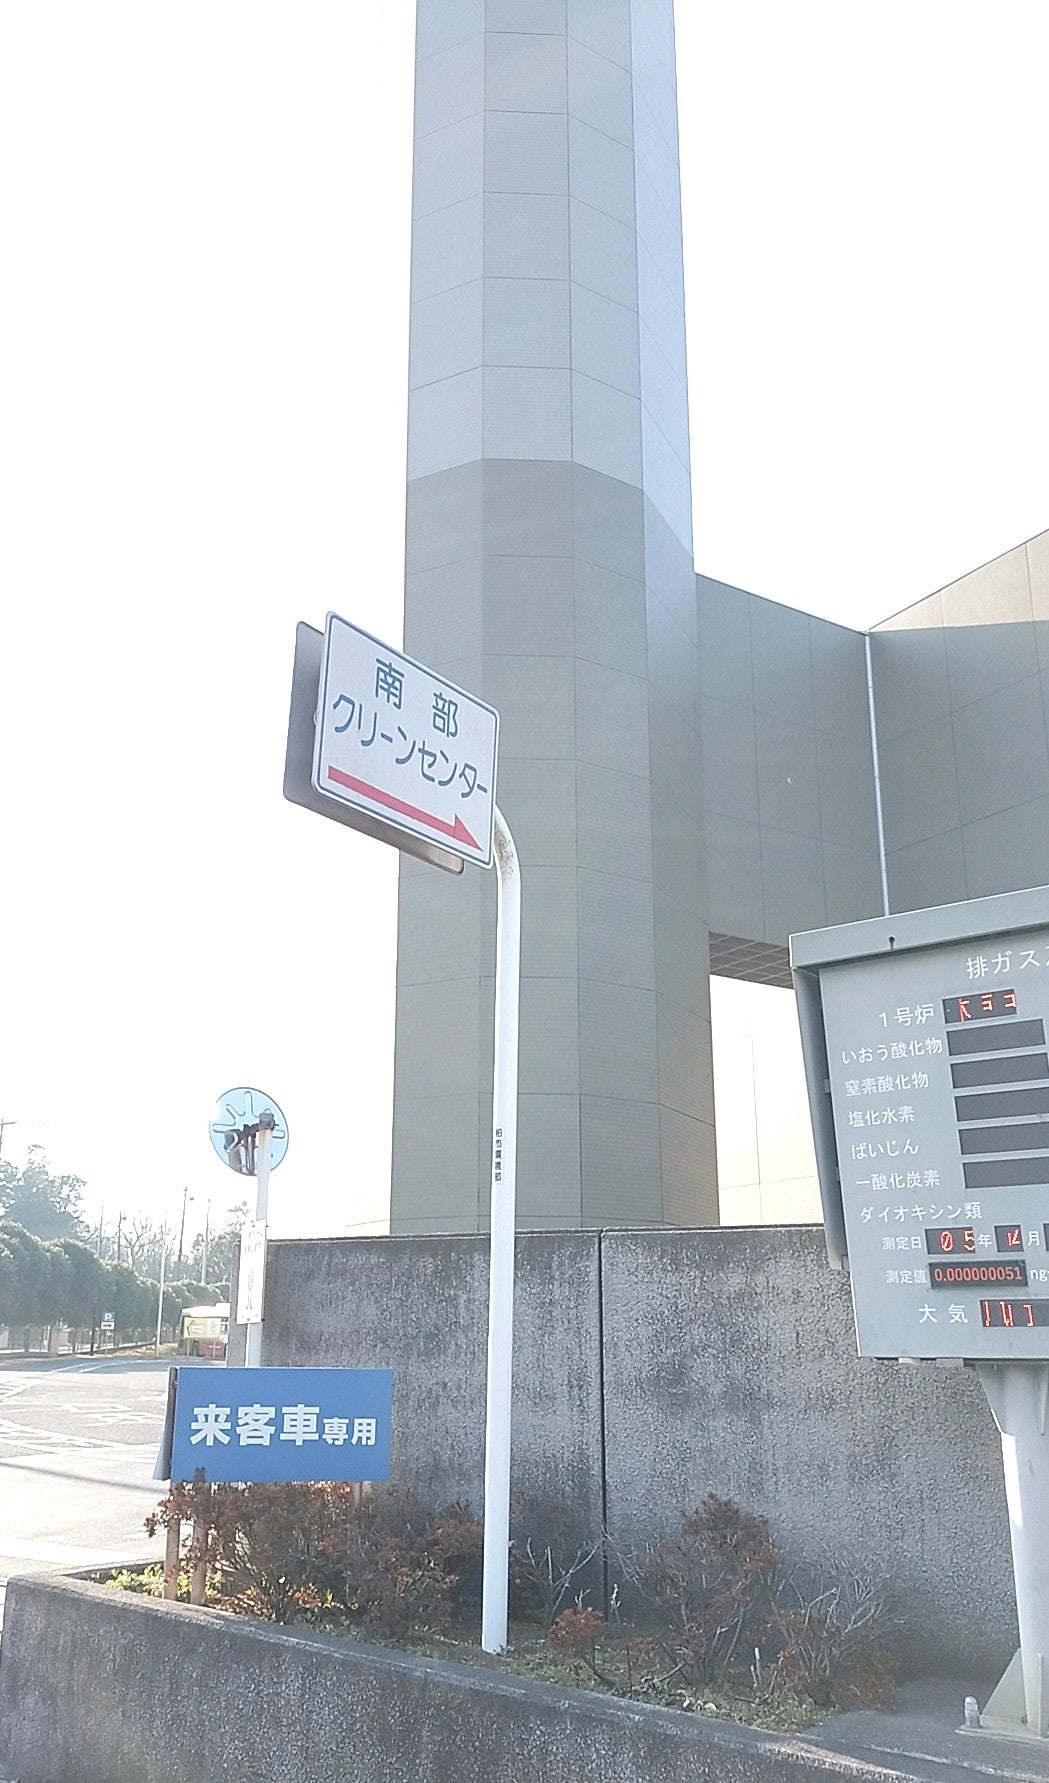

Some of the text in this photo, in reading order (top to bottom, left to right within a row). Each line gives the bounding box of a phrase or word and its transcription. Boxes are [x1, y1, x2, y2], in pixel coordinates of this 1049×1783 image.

[375, 657, 459, 738] 南部
[332, 694, 488, 799] クリーンセンター
[966, 945, 1049, 980] 排ガス
[842, 1037, 943, 1064] いおう酸化物
[845, 1072, 929, 1097] 窒素酸化物
[848, 1105, 915, 1128] 塩化水素
[851, 1139, 919, 1160] ばいじん
[855, 1170, 941, 1191] 一酸化炭素
[860, 1201, 982, 1224] ダイオキシン類
[882, 1235, 922, 1250] 測定日
[886, 1268, 927, 1284] 測定値
[189, 1403, 377, 1447] 来客車専用
